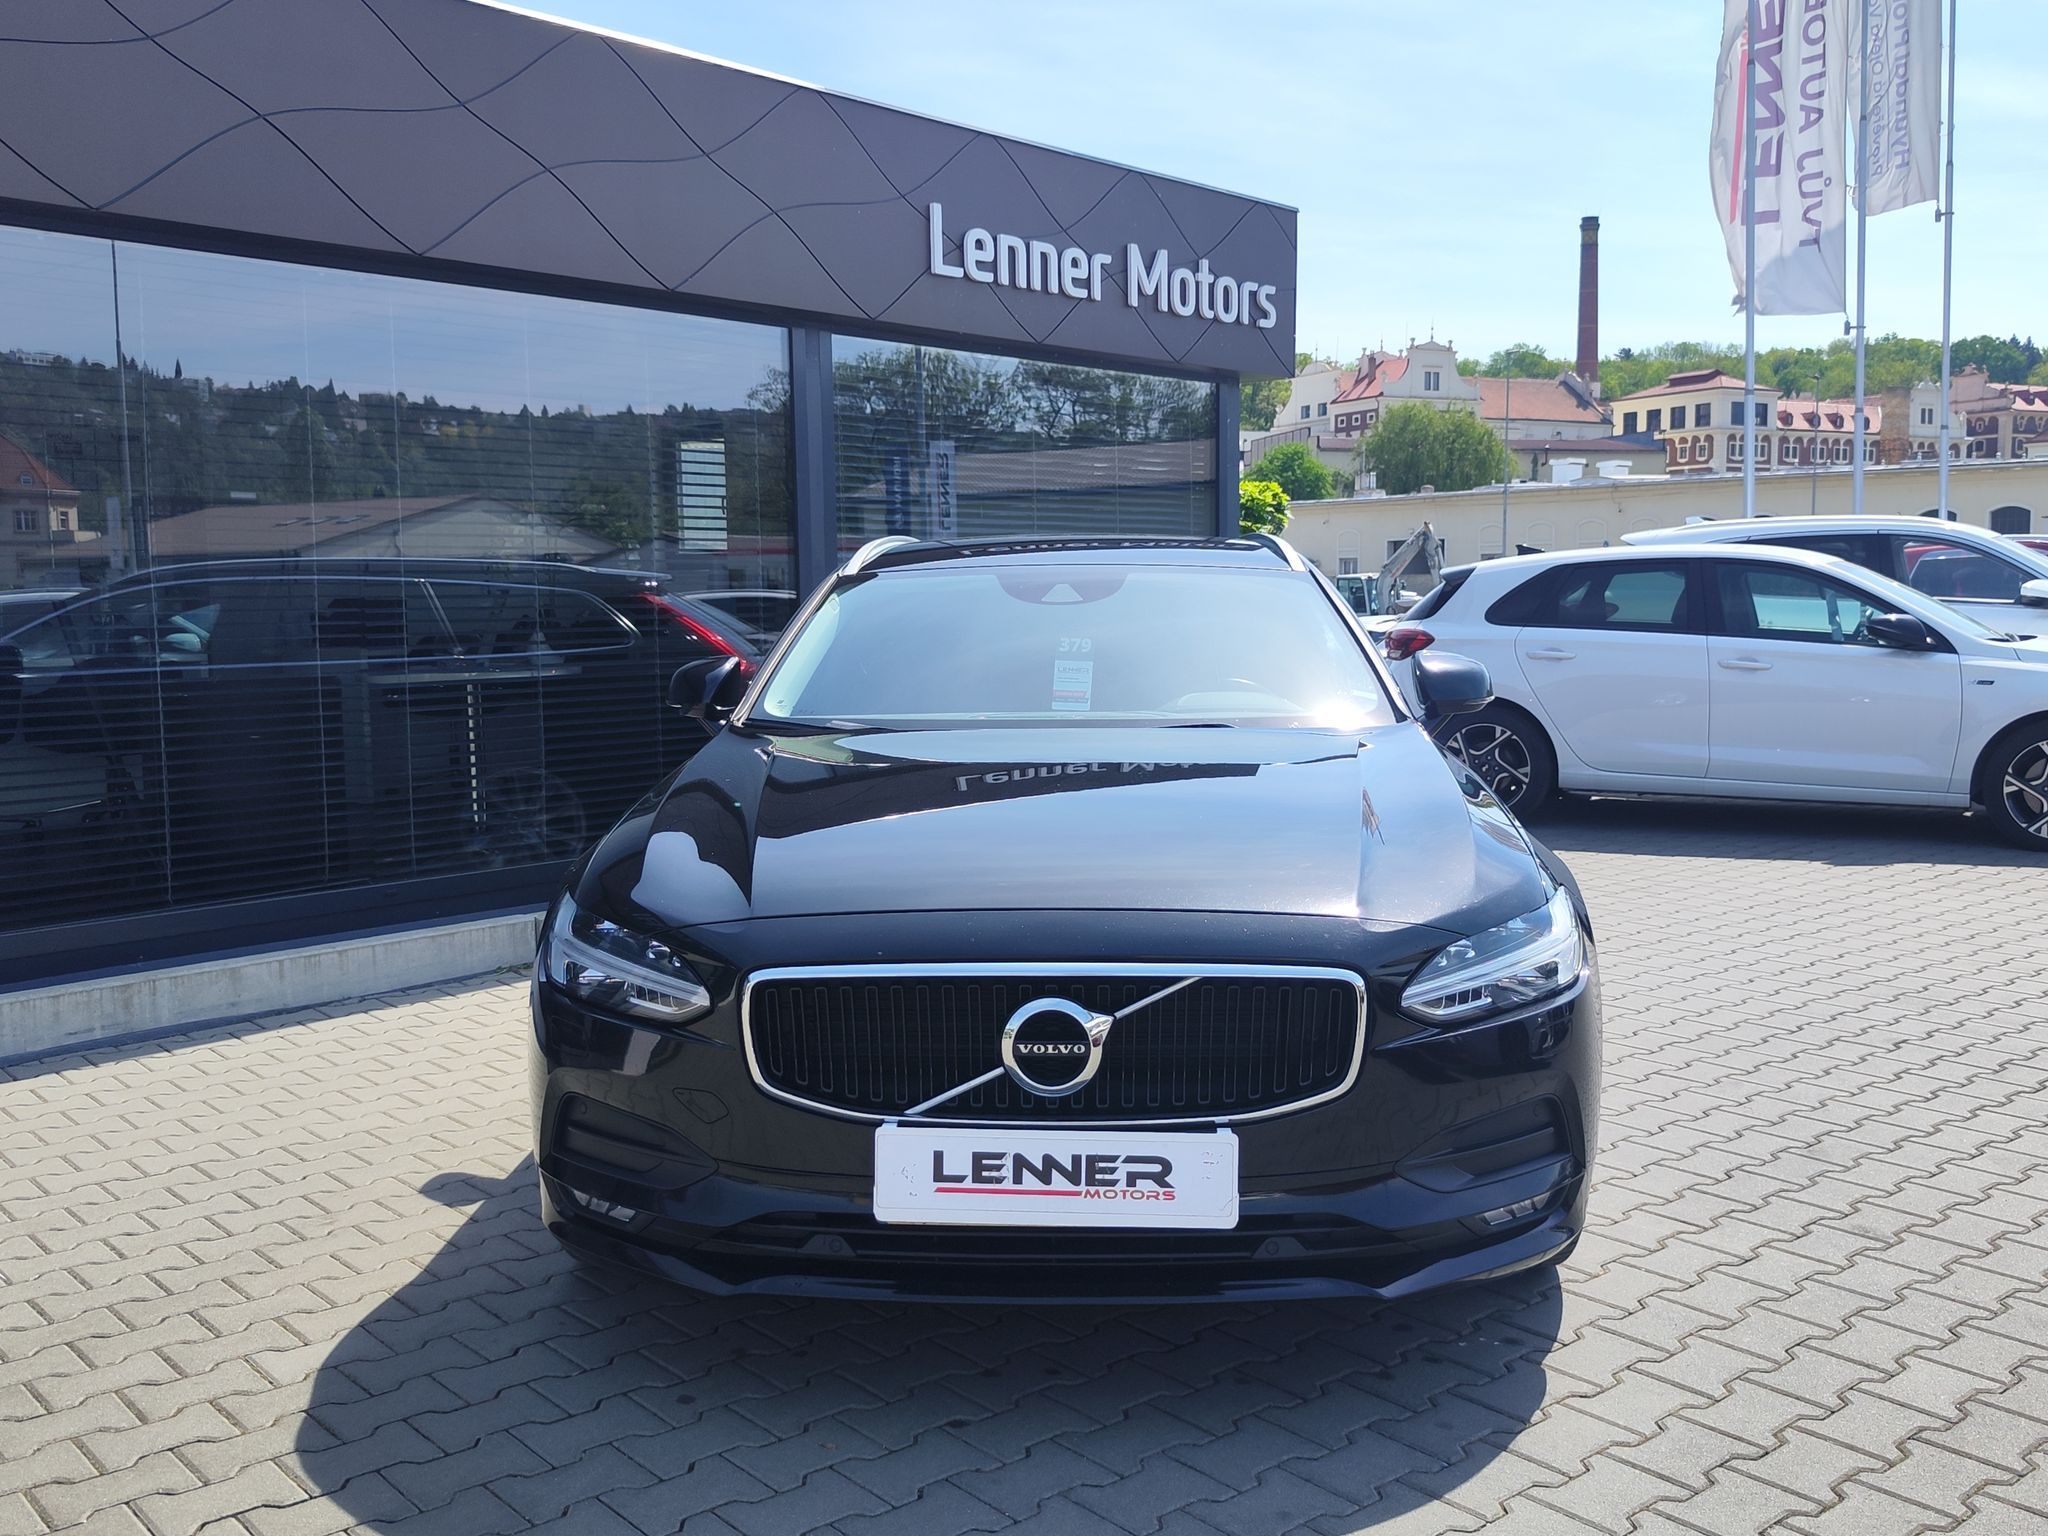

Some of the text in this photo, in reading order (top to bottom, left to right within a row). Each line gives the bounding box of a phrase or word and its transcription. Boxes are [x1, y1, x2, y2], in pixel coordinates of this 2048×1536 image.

[929, 202, 1277, 328] Lenner Motors
[1059, 638, 1093, 652] 379
[1016, 1043, 1087, 1055] VOLVO
[932, 1149, 1176, 1190] LENNER
[1083, 1188, 1177, 1202] MOTORS
